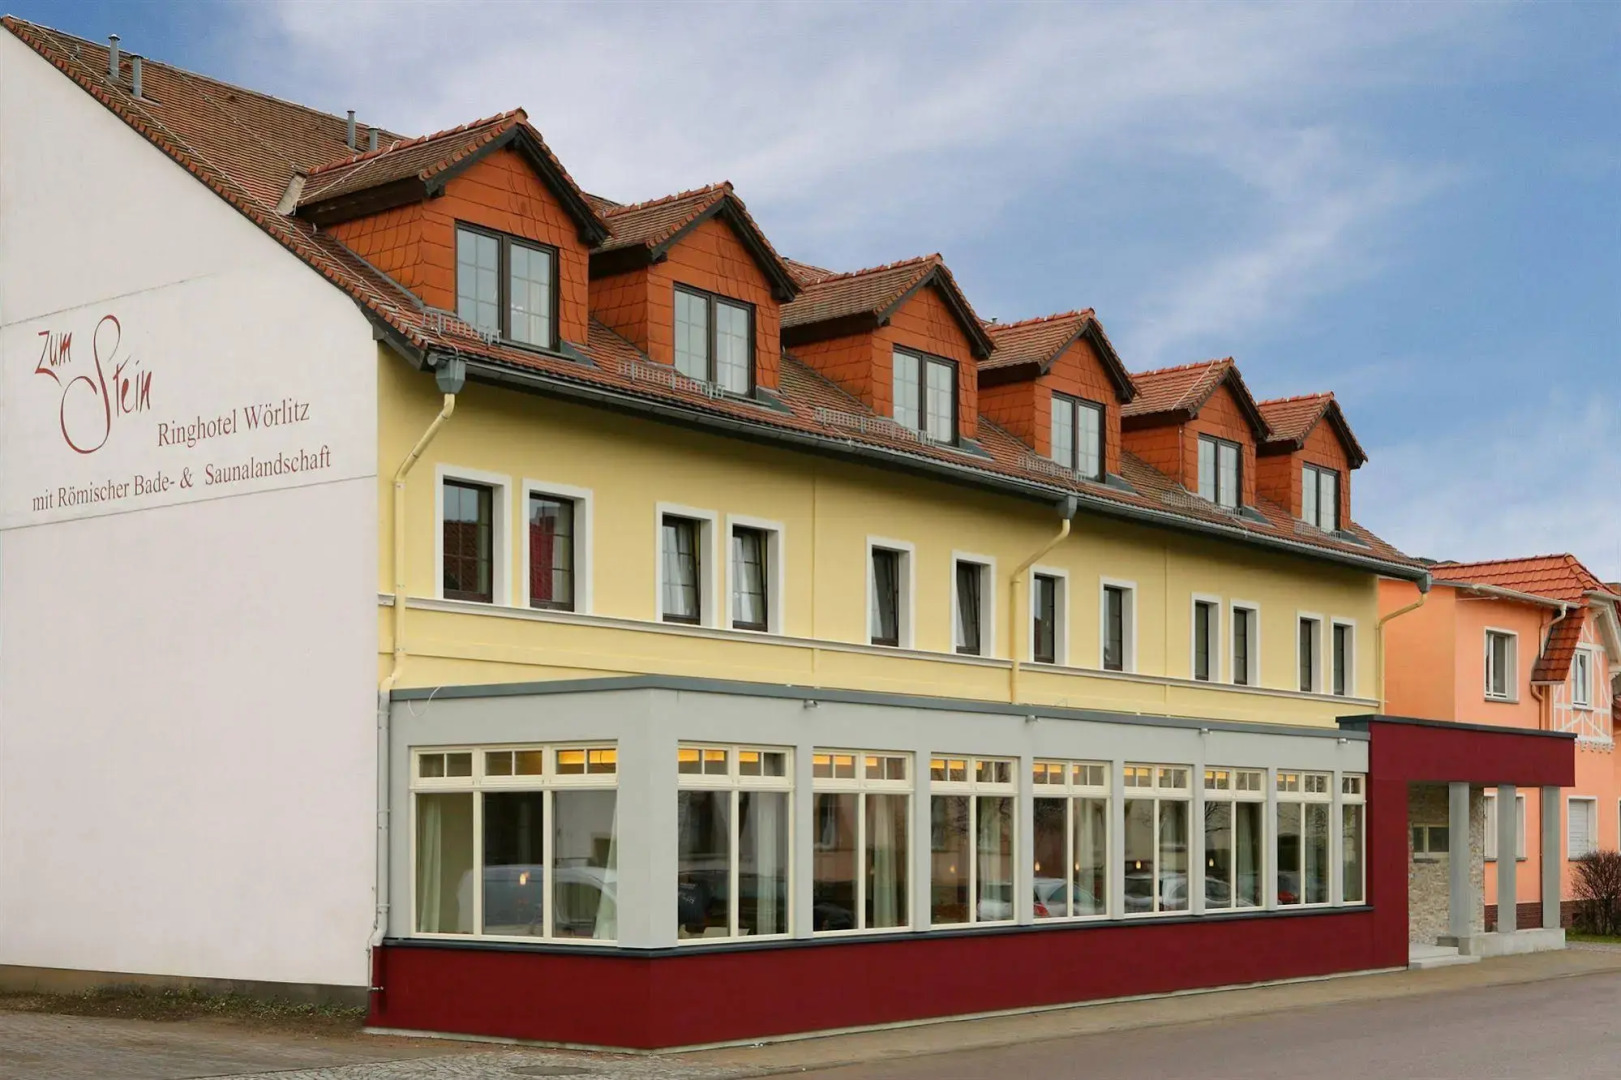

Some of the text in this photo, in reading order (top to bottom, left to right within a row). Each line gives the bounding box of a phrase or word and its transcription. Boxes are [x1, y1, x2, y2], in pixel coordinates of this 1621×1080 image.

[60, 314, 152, 454] Stein
[157, 398, 310, 447] Ringhotel Wörlitz
[32, 445, 331, 512] mit Römischer Bade- & Saunalandschaft
